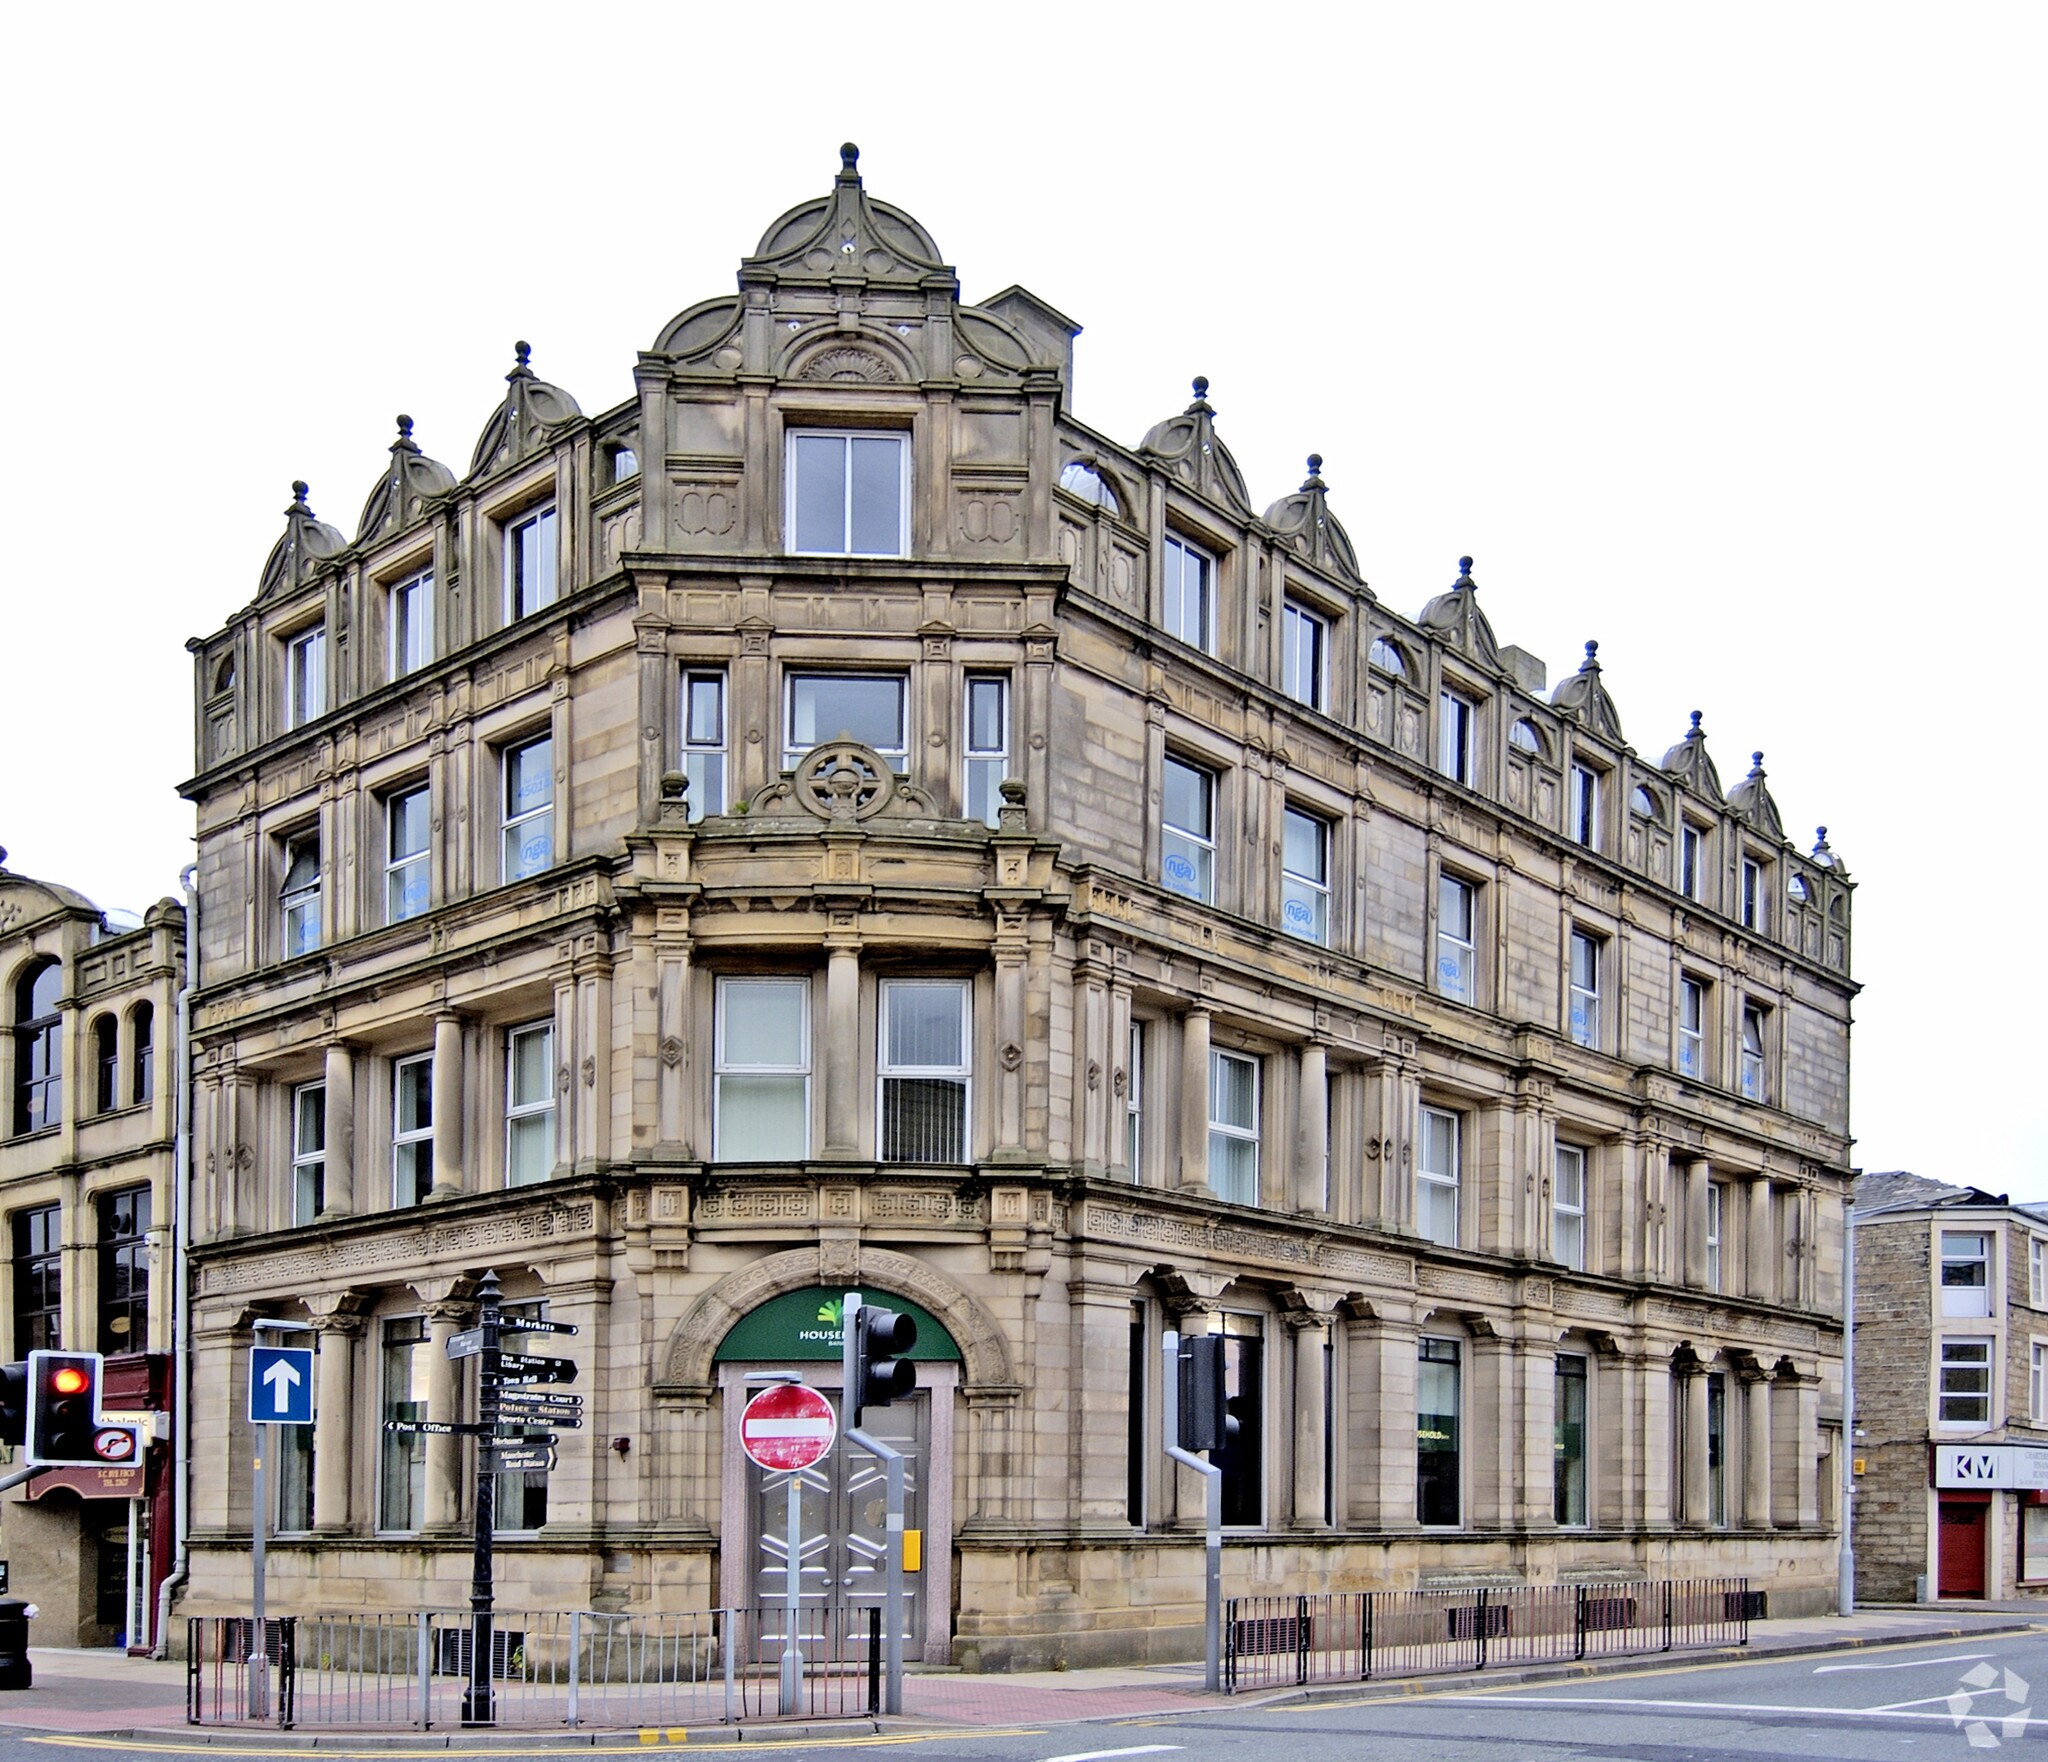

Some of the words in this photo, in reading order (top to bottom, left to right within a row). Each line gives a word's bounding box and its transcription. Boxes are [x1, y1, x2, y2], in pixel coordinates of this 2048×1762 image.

[516, 1318, 555, 1331] Markets
[501, 1354, 514, 1362] Bus
[520, 1356, 546, 1365] Station
[522, 1375, 538, 1384] Hall
[549, 1394, 573, 1404] Court
[499, 1403, 529, 1413] Police
[537, 1405, 571, 1415] Station
[498, 1414, 525, 1425] Sports
[527, 1416, 555, 1426] Centre
[396, 1422, 416, 1431] Post
[422, 1423, 452, 1433] Office
[1952, 1455, 1998, 1479] KM
